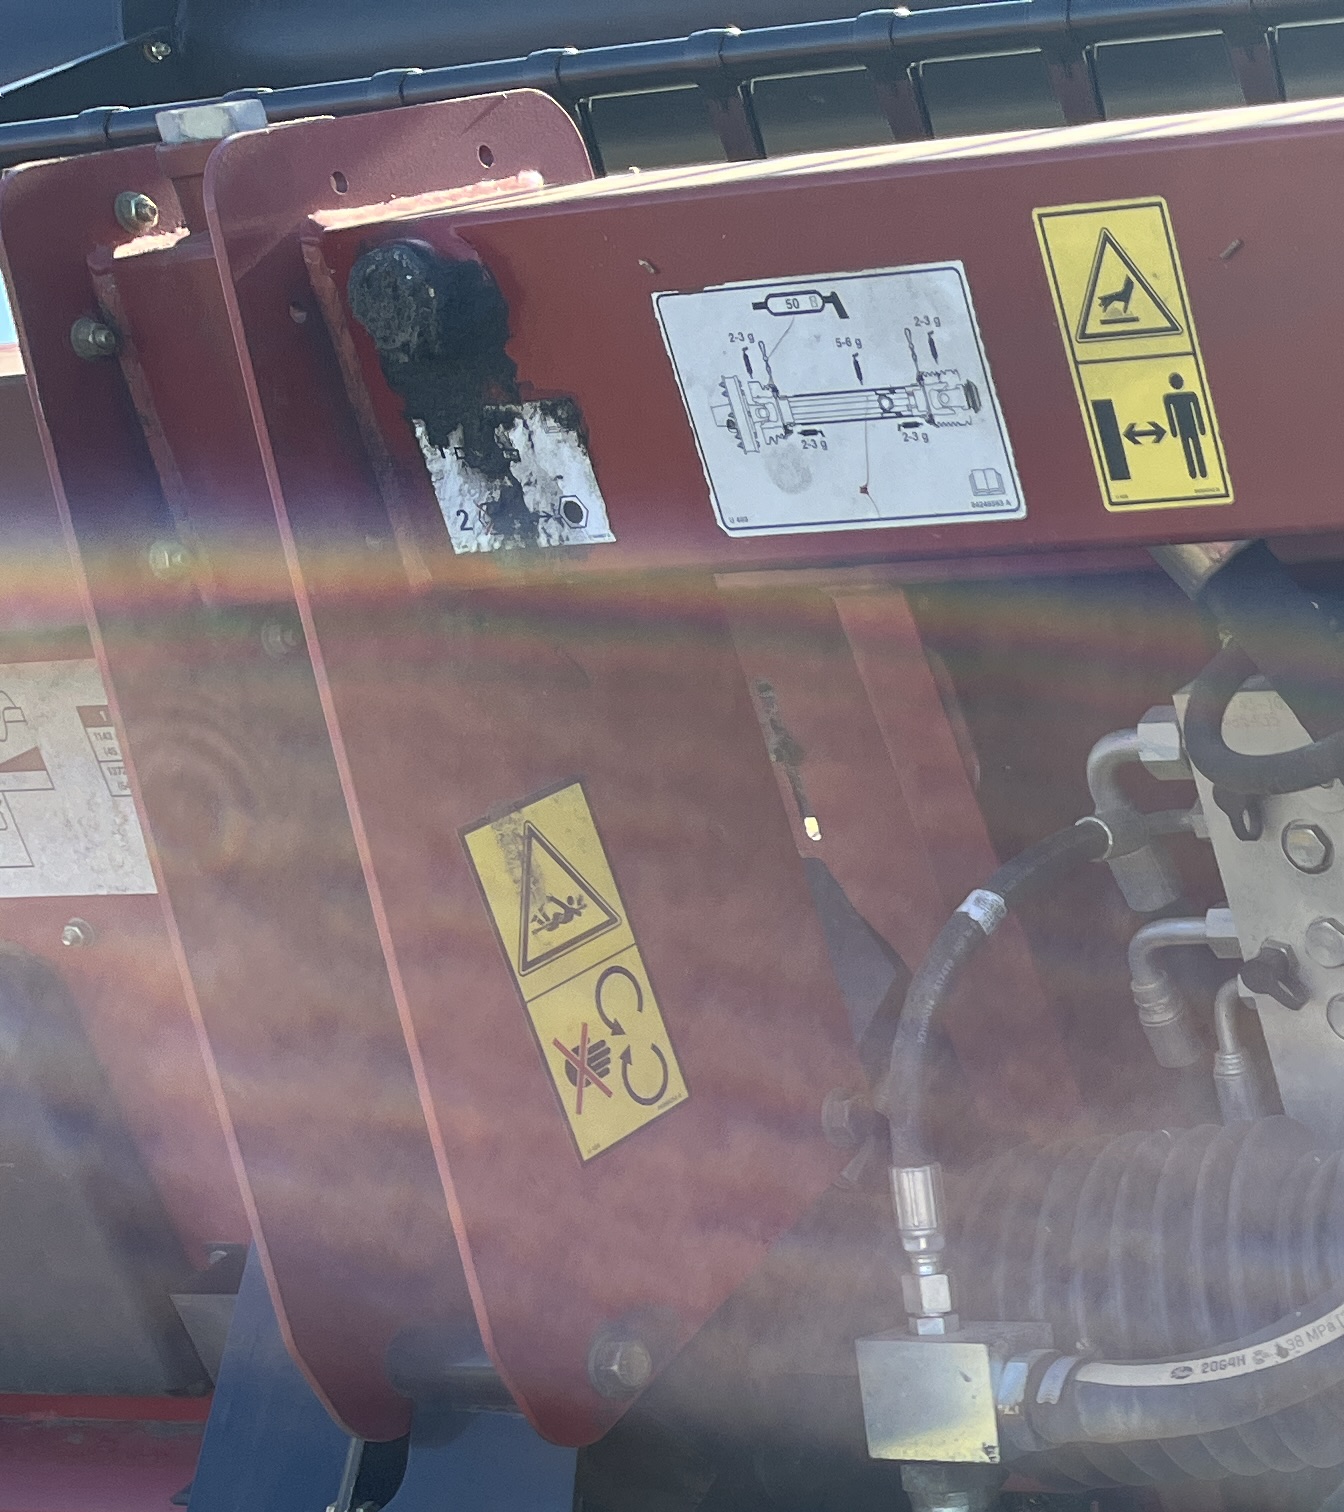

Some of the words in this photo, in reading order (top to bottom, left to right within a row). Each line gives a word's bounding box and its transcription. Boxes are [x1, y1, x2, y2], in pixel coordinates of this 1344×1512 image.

[785, 298, 800, 309] 50
[913, 315, 931, 327] 2-3
[728, 332, 745, 343] 2-3
[902, 431, 919, 442] 2-3
[801, 438, 818, 449] 2-3
[456, 509, 474, 531] 2
